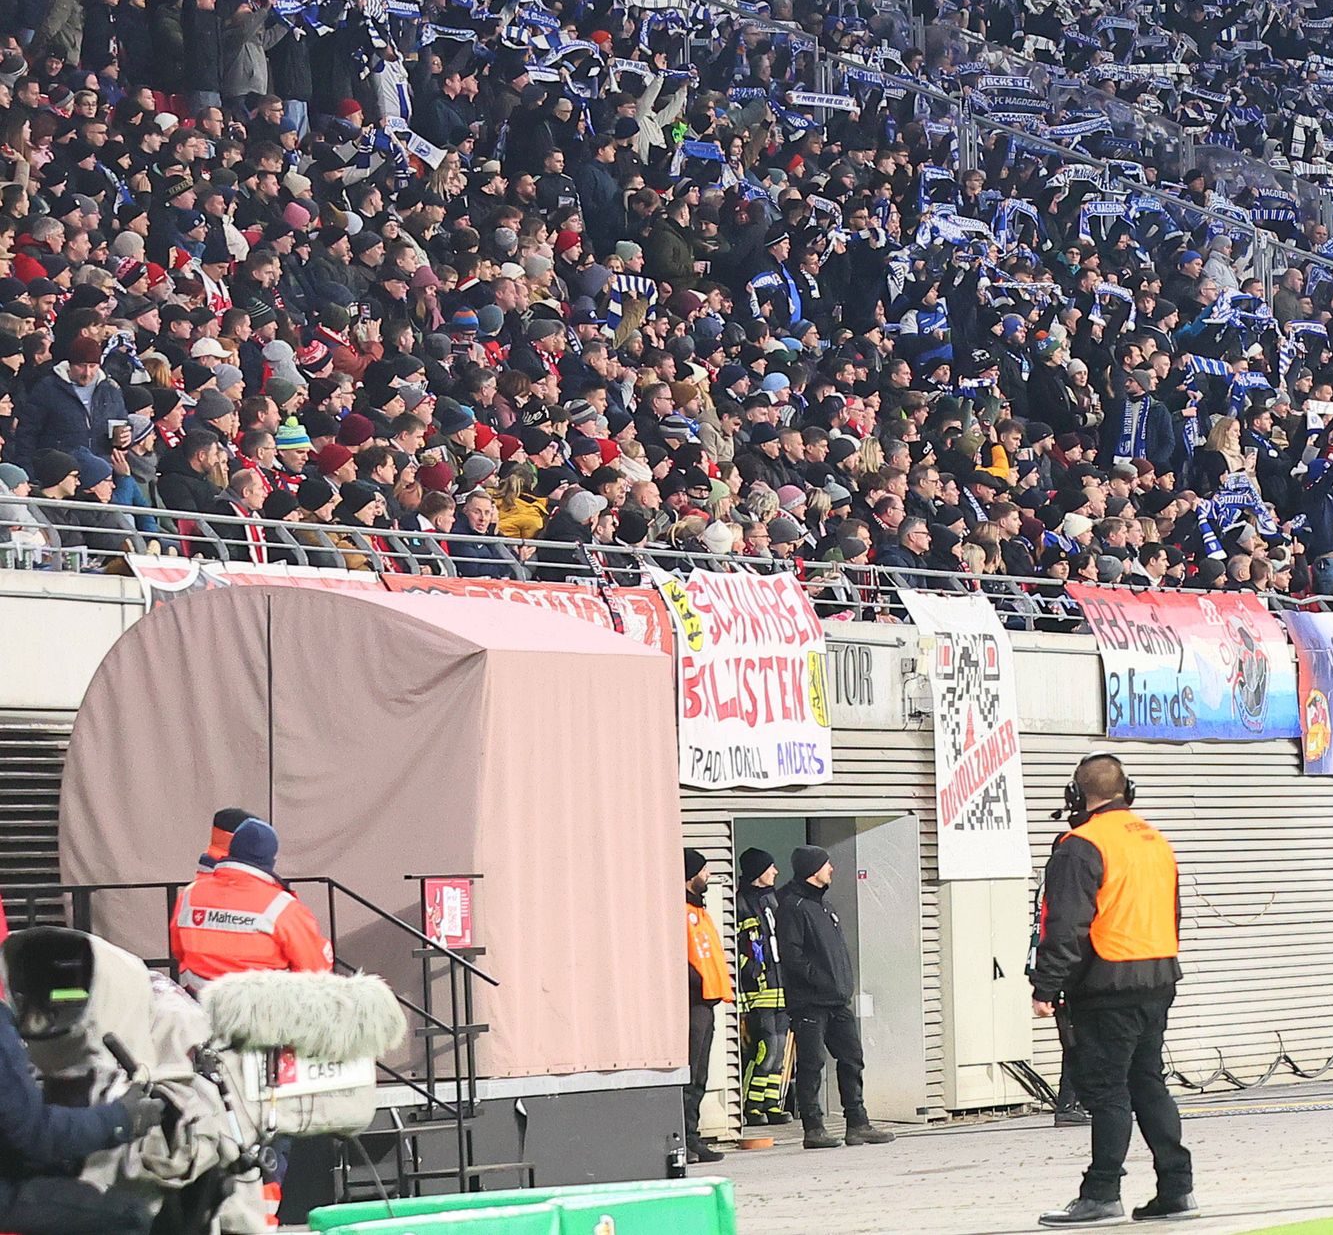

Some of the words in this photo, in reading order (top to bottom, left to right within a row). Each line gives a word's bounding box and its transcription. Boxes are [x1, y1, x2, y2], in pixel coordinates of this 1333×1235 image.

[684, 573, 824, 646] SCHWABEN
[1083, 597, 1129, 650] RB
[1109, 671, 1124, 728] &
[776, 740, 825, 777] ANDERS
[208, 909, 258, 926] Malteser
[307, 1060, 345, 1081] CAST
